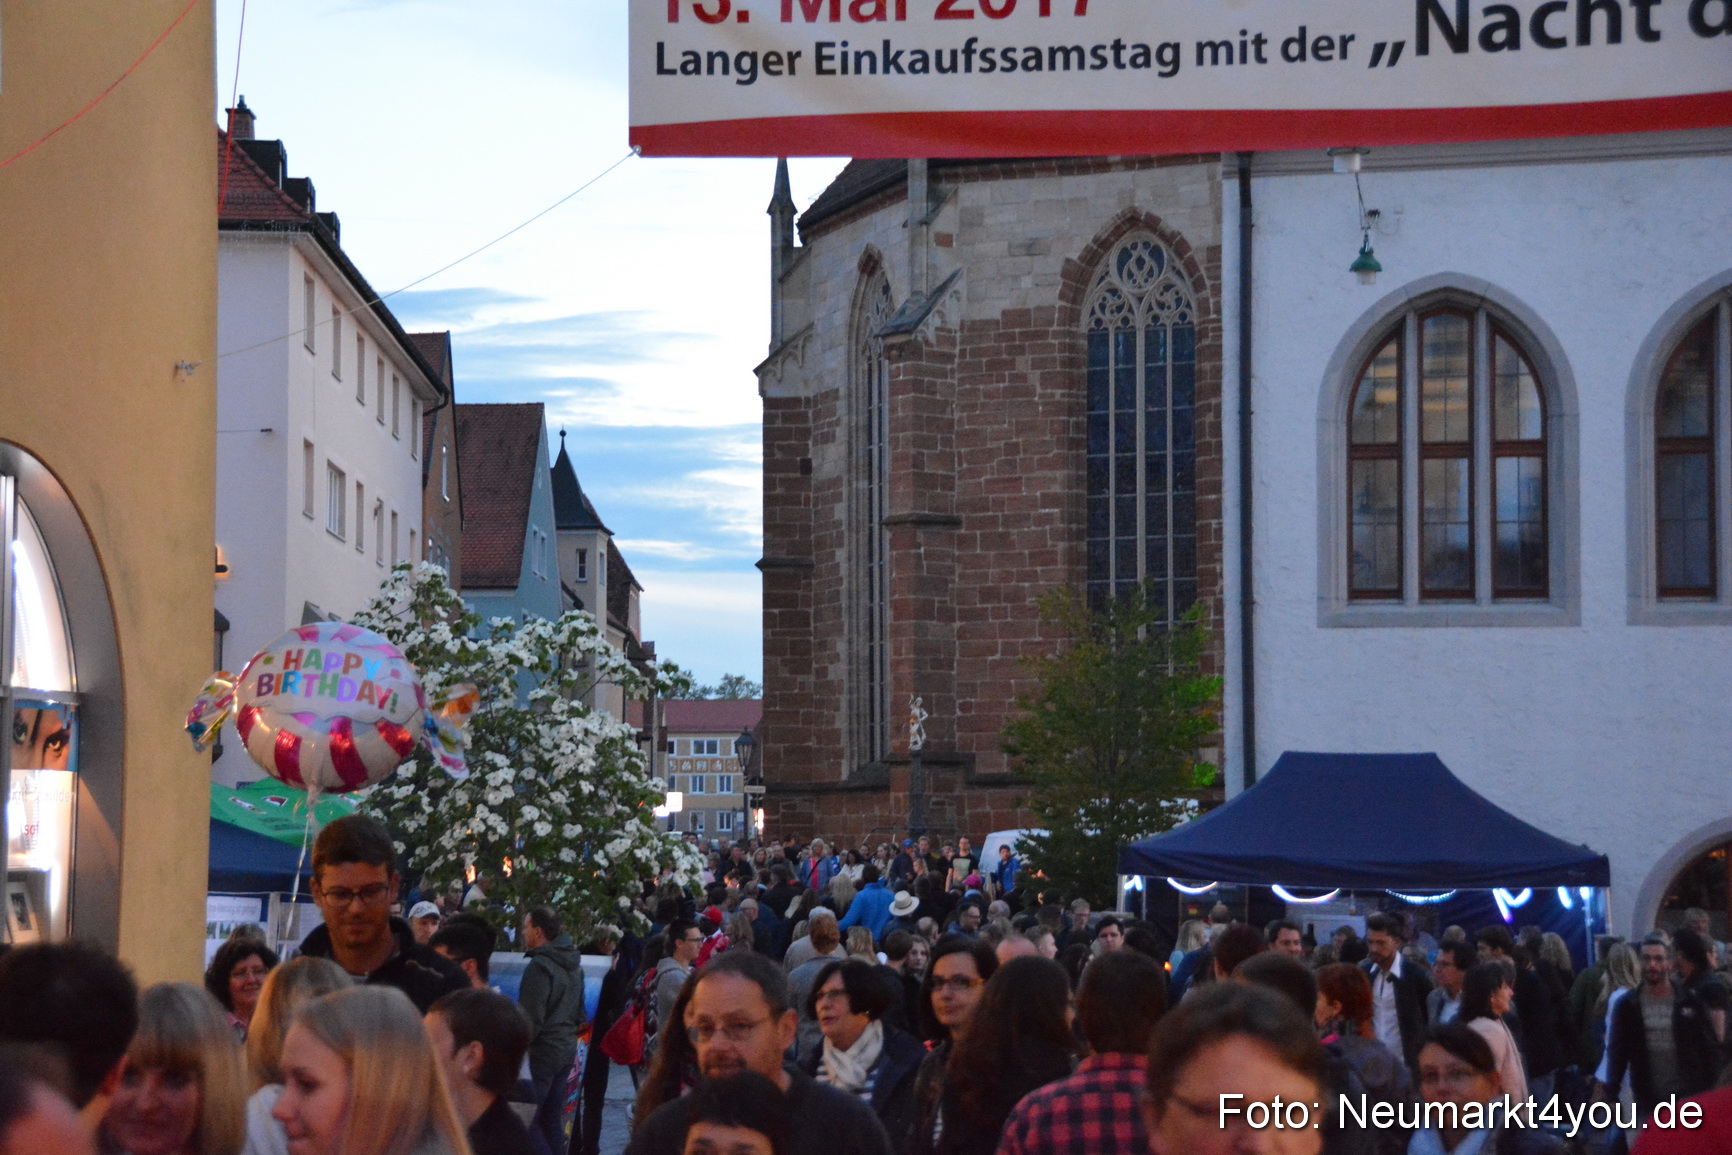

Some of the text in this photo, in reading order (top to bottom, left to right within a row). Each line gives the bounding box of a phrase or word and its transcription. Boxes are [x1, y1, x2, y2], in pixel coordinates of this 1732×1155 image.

[656, 41, 802, 86] Langer
[815, 37, 1181, 78] Einkaufssamstag
[1195, 28, 1268, 68] mit
[1280, 25, 1355, 63] der
[283, 648, 382, 681] HAPPY
[256, 670, 399, 714] BIRTHDAY!
